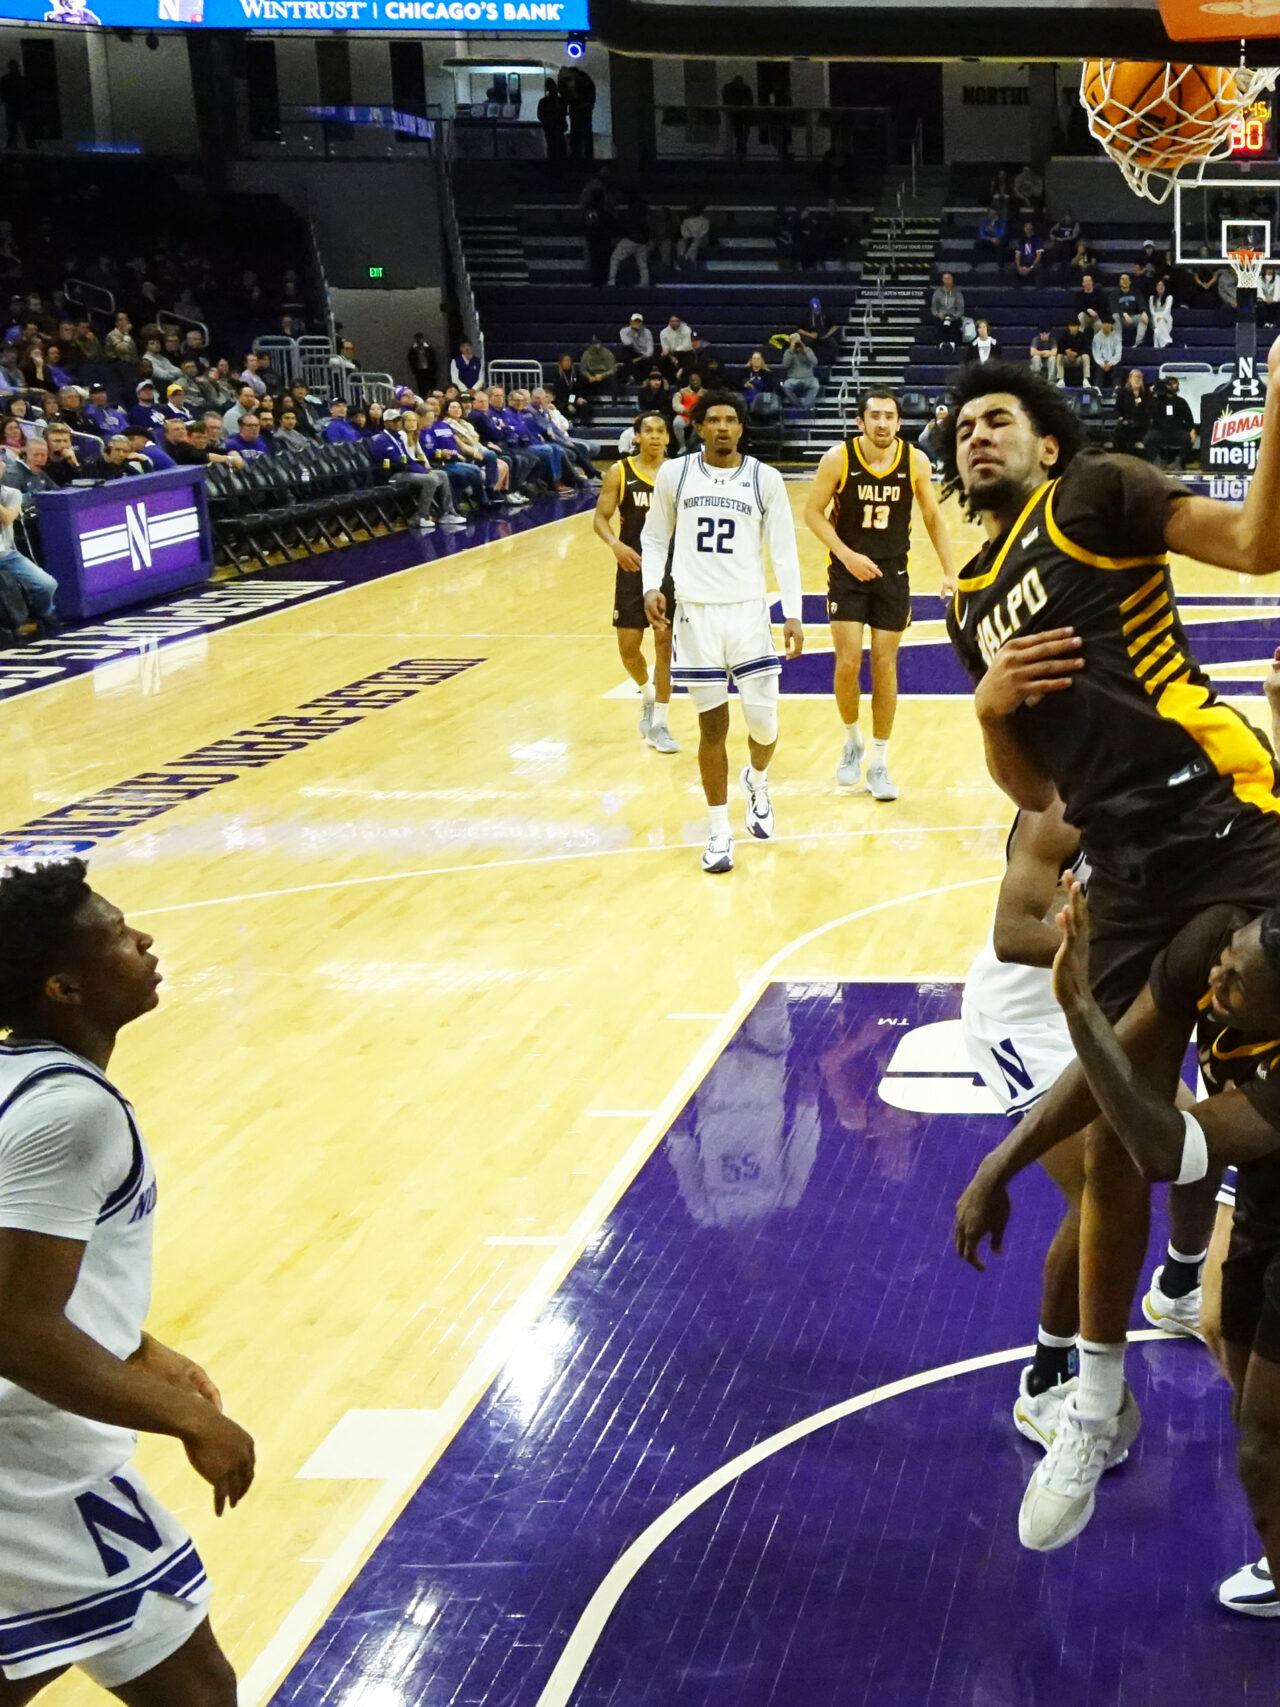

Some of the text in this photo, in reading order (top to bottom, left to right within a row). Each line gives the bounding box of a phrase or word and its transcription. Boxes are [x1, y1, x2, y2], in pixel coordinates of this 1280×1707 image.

[243, 0, 562, 21] WINTRUST CHICAGO'S BANK
[1239, 357, 1253, 378] N
[1209, 441, 1259, 470] meij
[683, 496, 753, 516] NORTHWESTERN
[858, 484, 900, 502] VALPO
[862, 504, 890, 529] 13
[125, 502, 152, 572] N
[696, 517, 735, 554] 22
[162, 657, 488, 769] WELSH-RYAN
[990, 1037, 1035, 1100] N
[75, 1475, 162, 1578] N
